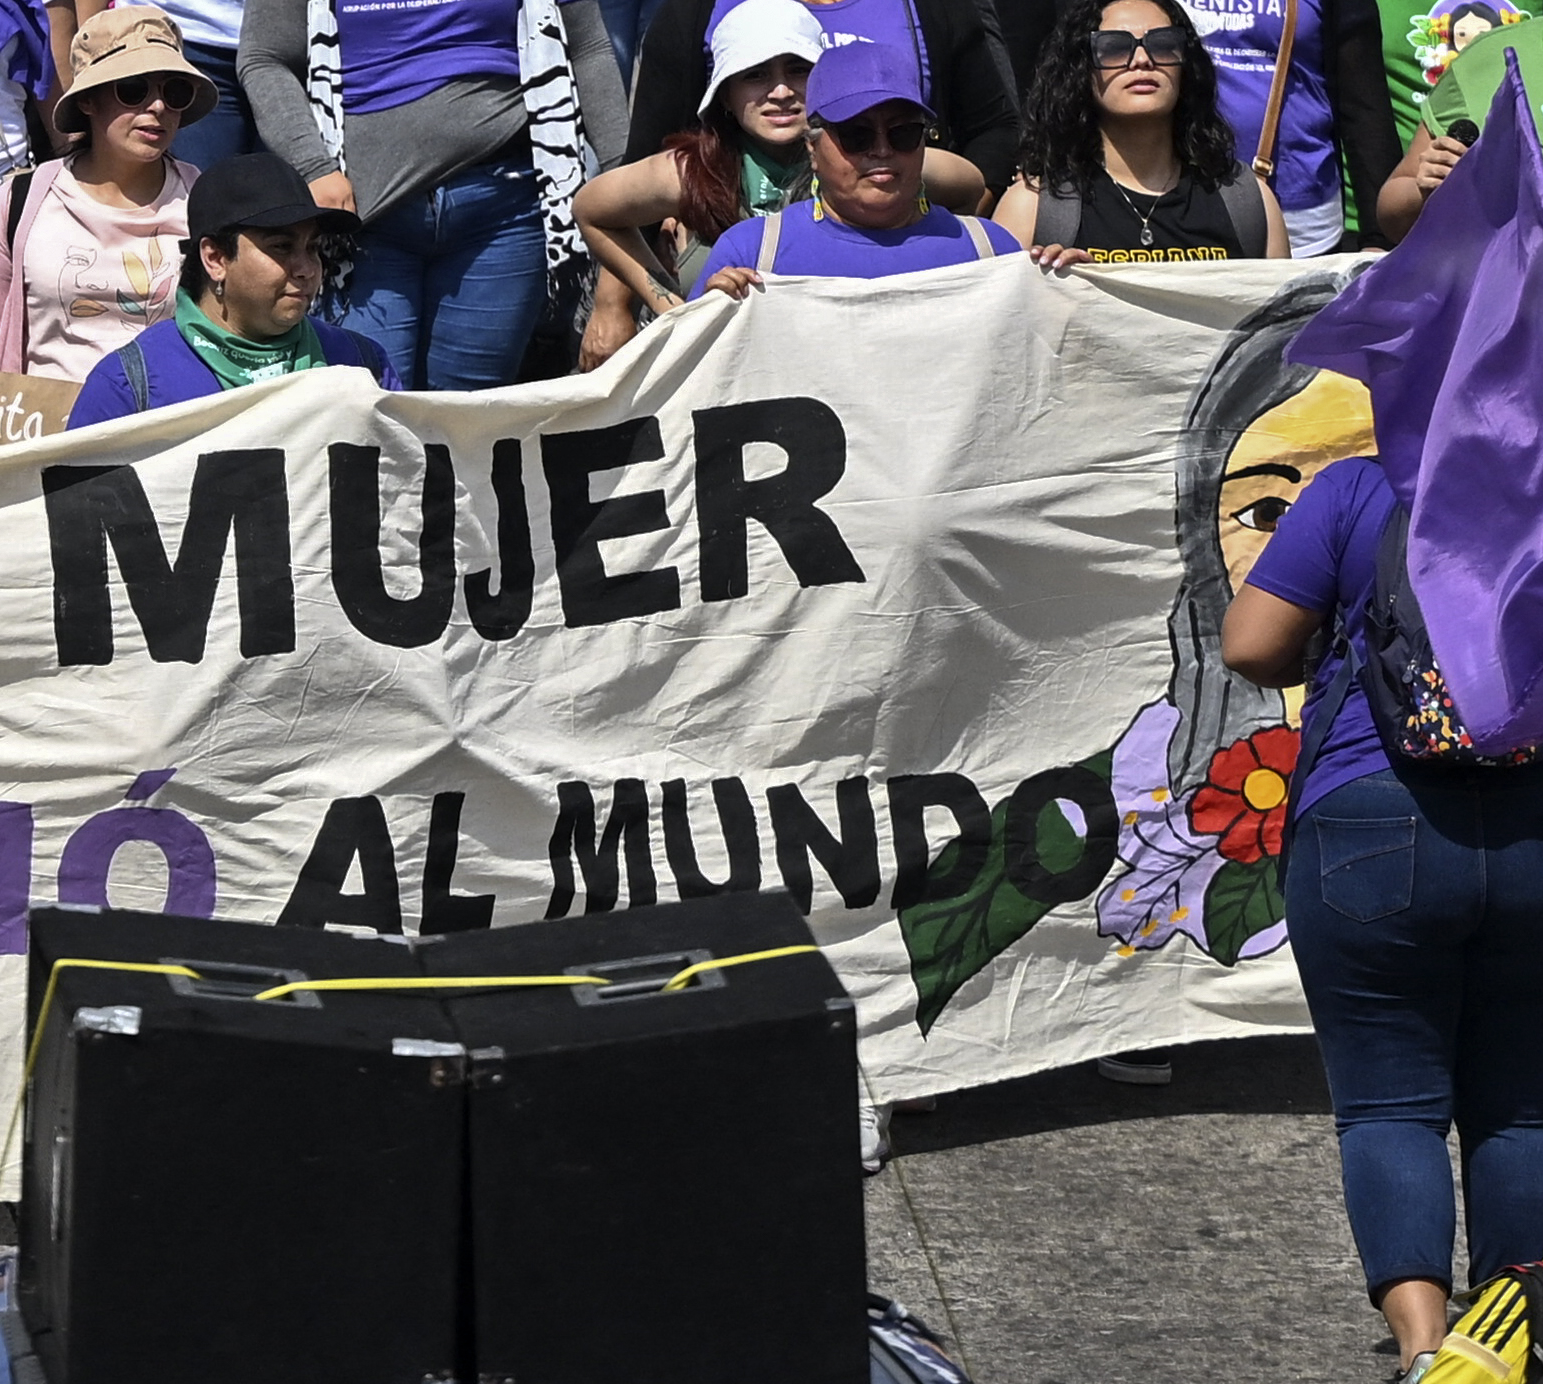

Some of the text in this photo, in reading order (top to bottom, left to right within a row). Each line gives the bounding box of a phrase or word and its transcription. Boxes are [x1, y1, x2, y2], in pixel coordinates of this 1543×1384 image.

[41, 395, 866, 669] MUJER
[276, 791, 497, 937] AL
[545, 764, 1117, 920] MUNDO
